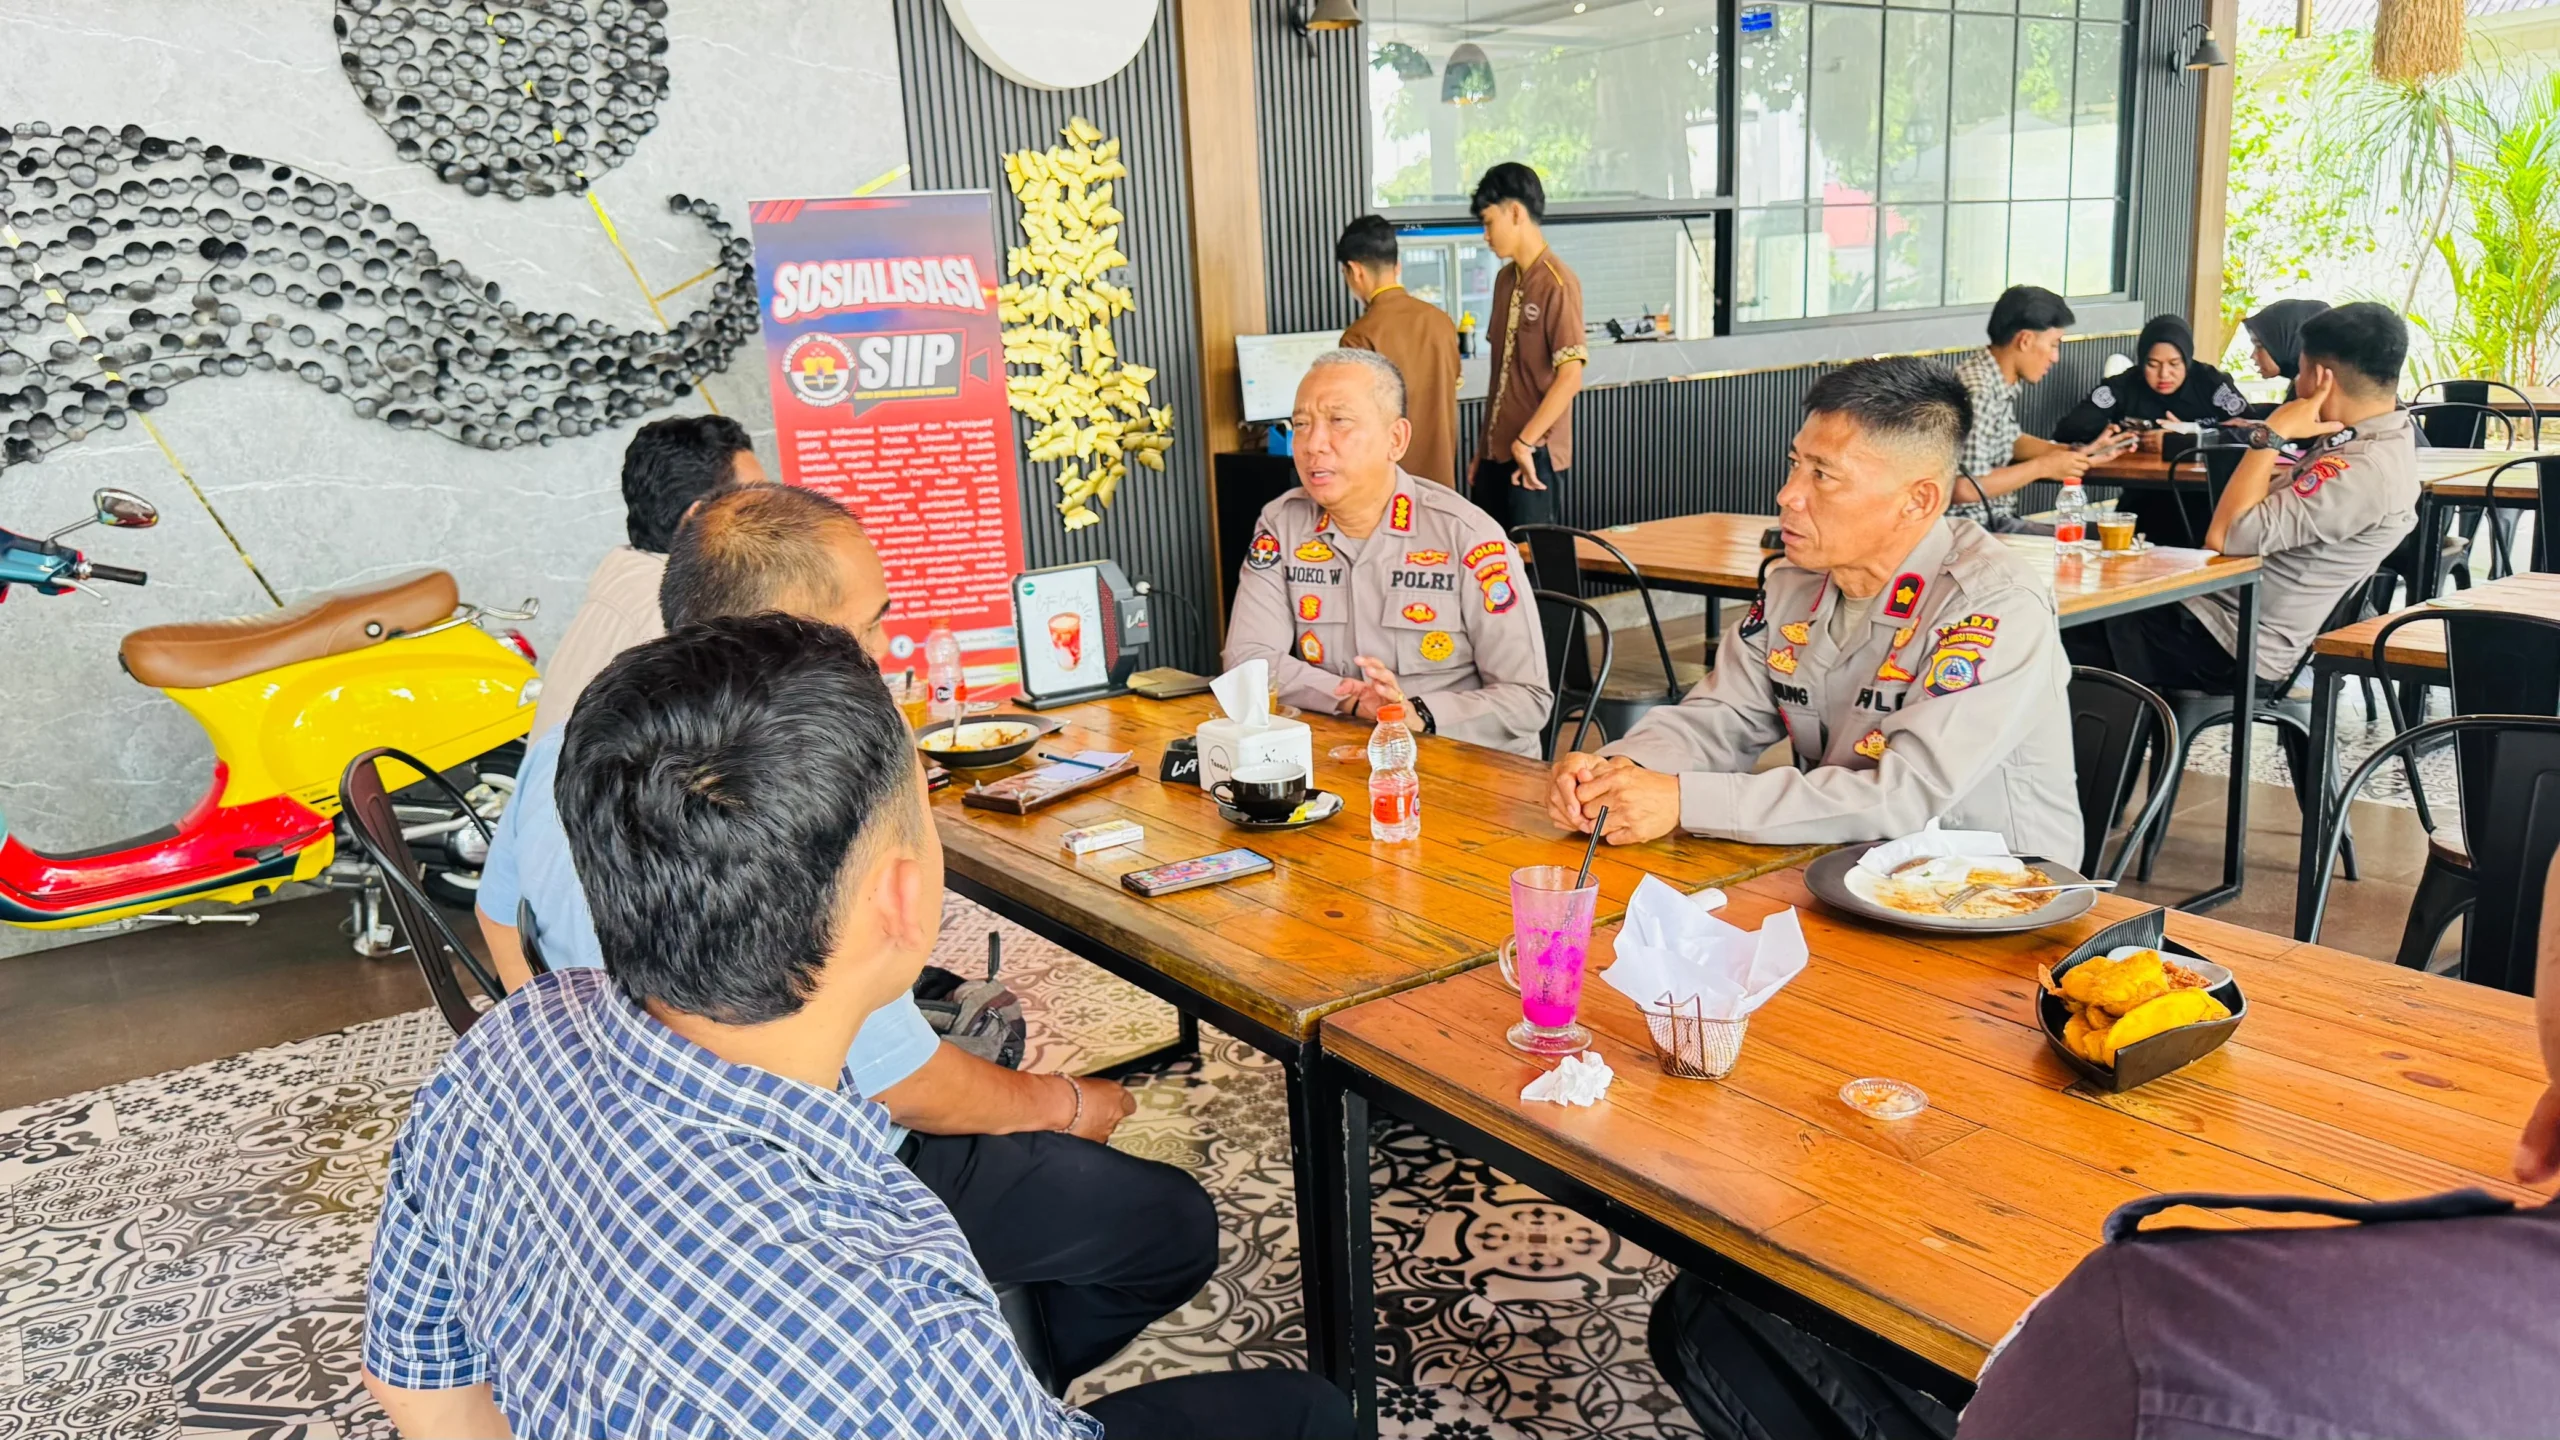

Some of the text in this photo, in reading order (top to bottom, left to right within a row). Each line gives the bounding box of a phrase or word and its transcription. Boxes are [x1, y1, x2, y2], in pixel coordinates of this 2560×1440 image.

[774, 257, 987, 320] SOSIALISASI
[857, 333, 956, 390] SIIP
[923, 422, 942, 431] dan
[881, 435, 909, 445] Polda
[961, 430, 995, 441] Tengah
[835, 449, 875, 461] program
[879, 447, 916, 458] layanan
[920, 443, 962, 454] informasi
[967, 441, 996, 452] publik
[843, 460, 873, 470] media
[908, 456, 935, 465] resmi
[939, 454, 961, 464] Polri
[965, 451, 997, 463] seperti
[980, 463, 998, 472] dan
[857, 482, 897, 493] Program
[934, 476, 958, 486] hadir
[971, 474, 999, 483] untuk
[880, 492, 916, 502] layanan
[925, 487, 967, 498] informasi
[976, 486, 1000, 496] yang
[977, 497, 1001, 506] serta
[977, 507, 1002, 516] tidak
[956, 520, 976, 530] juga
[977, 518, 1003, 528] dapat
[883, 534, 924, 545] memberi
[960, 552, 988, 562] umum
[989, 550, 1006, 559] dan
[1467, 542, 1504, 566] POLDA
[1391, 569, 1456, 592] POLRI
[936, 587, 959, 596] serta
[908, 600, 926, 609] dan
